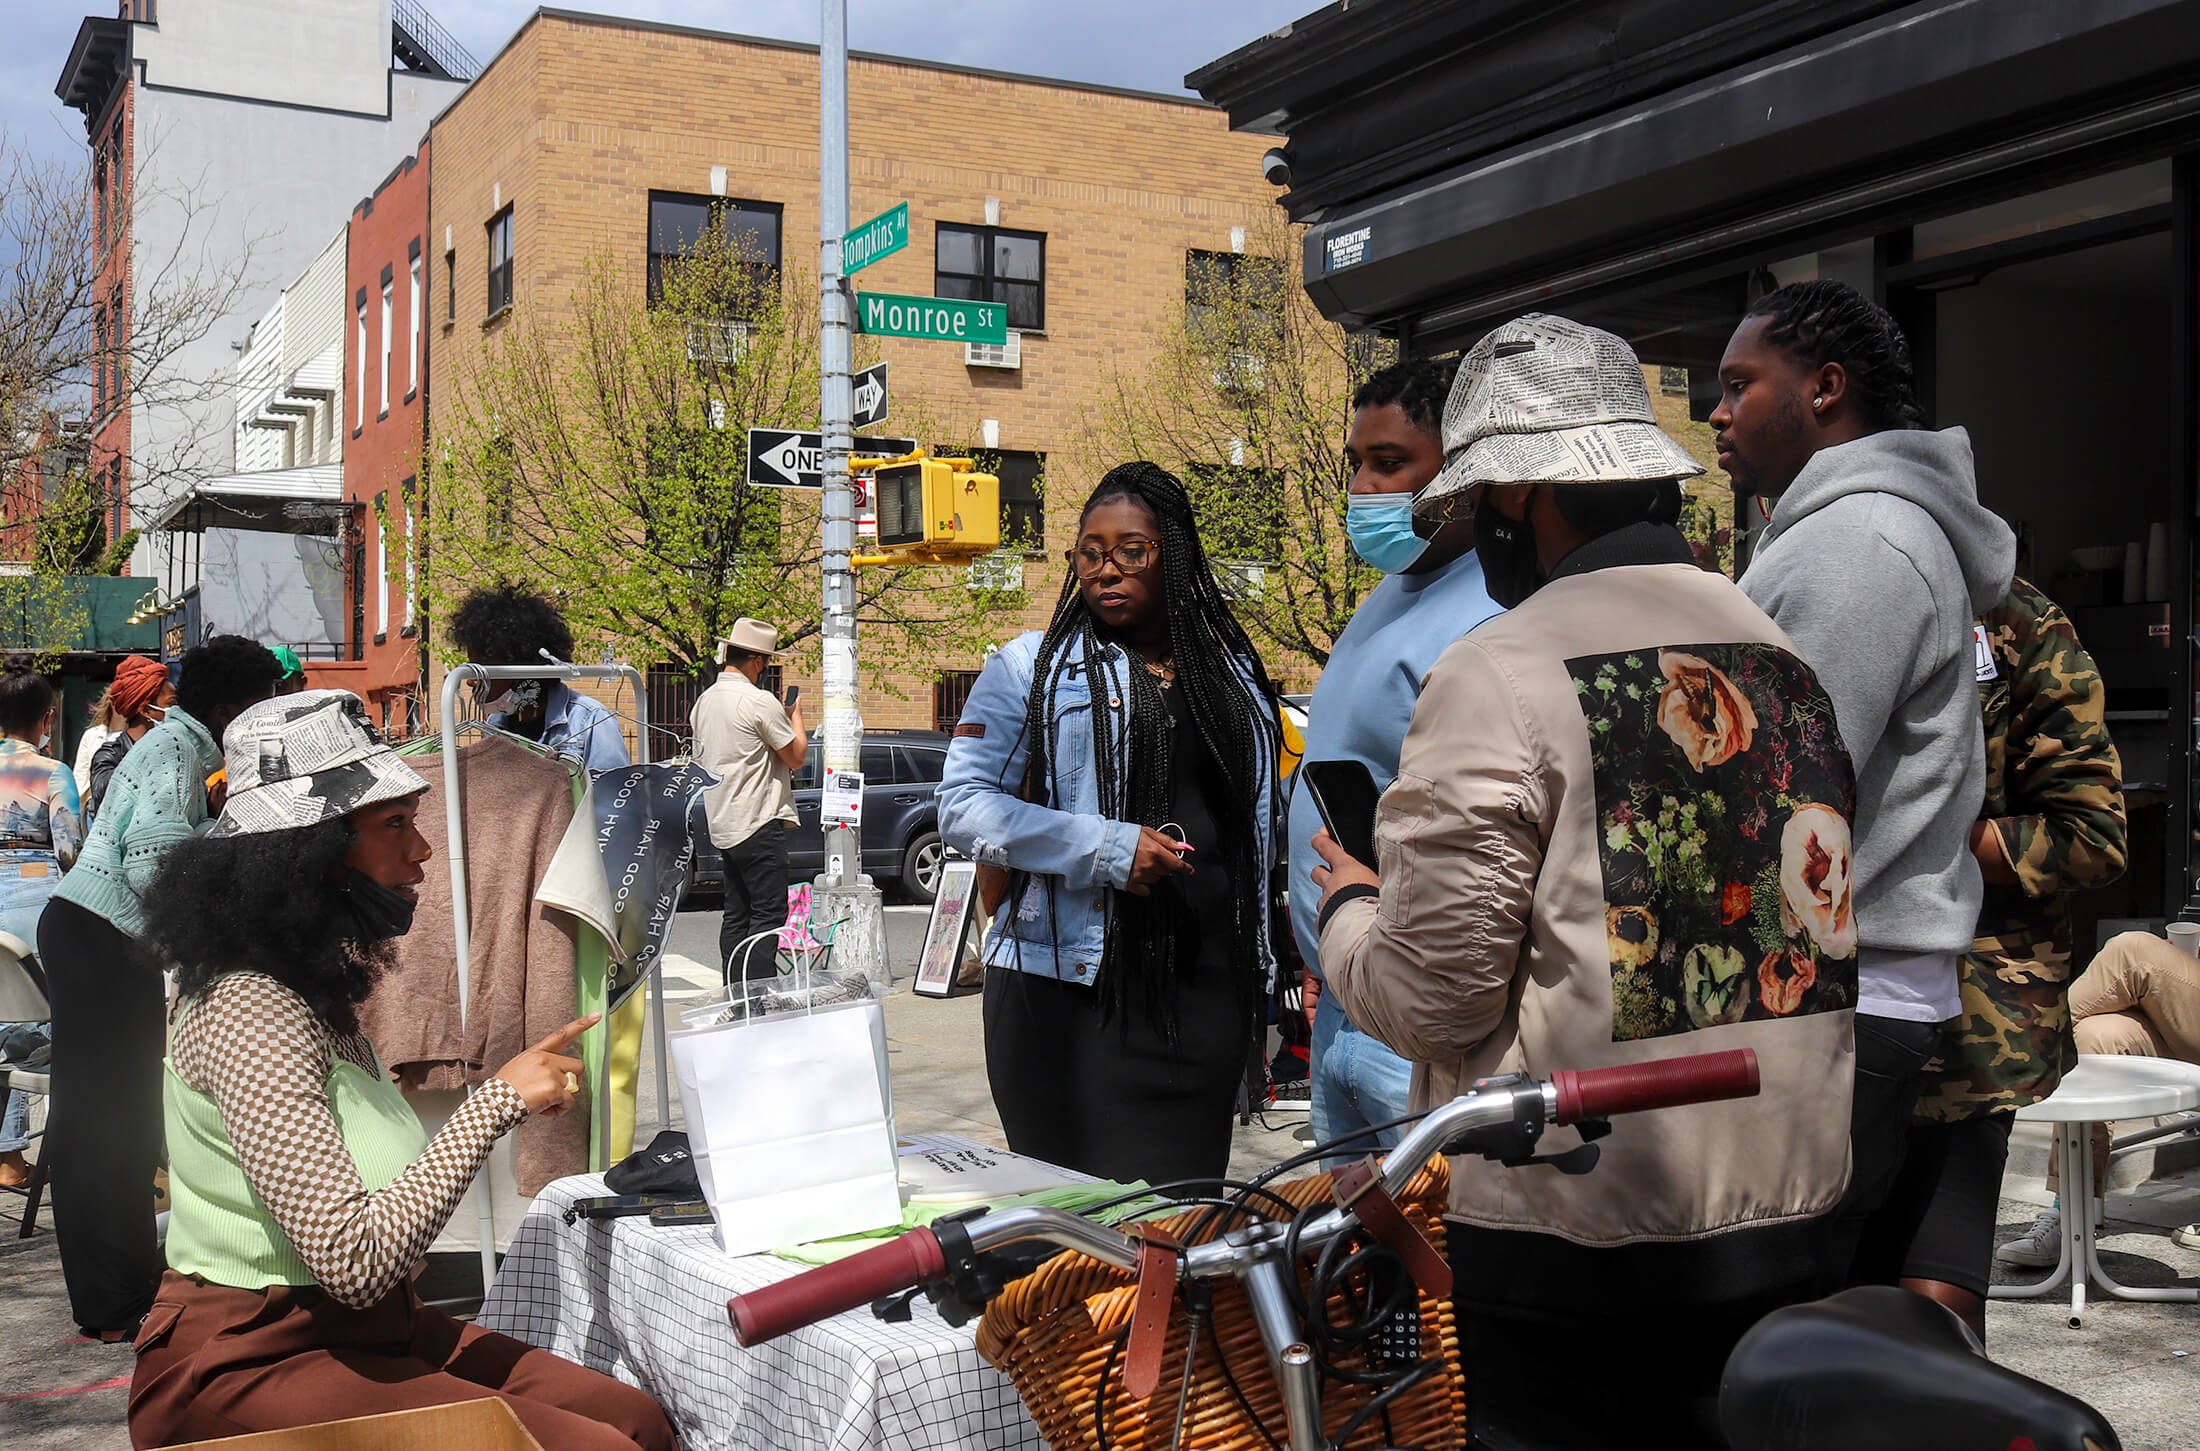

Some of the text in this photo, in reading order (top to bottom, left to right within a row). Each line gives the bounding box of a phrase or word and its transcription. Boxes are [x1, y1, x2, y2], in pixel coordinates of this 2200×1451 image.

[843, 212, 906, 268] Tompkins Av
[1327, 226, 1371, 253] FLORENTINE
[867, 298, 993, 336] Monroe St
[857, 385, 877, 410] WAY
[782, 448, 822, 472] ONE
